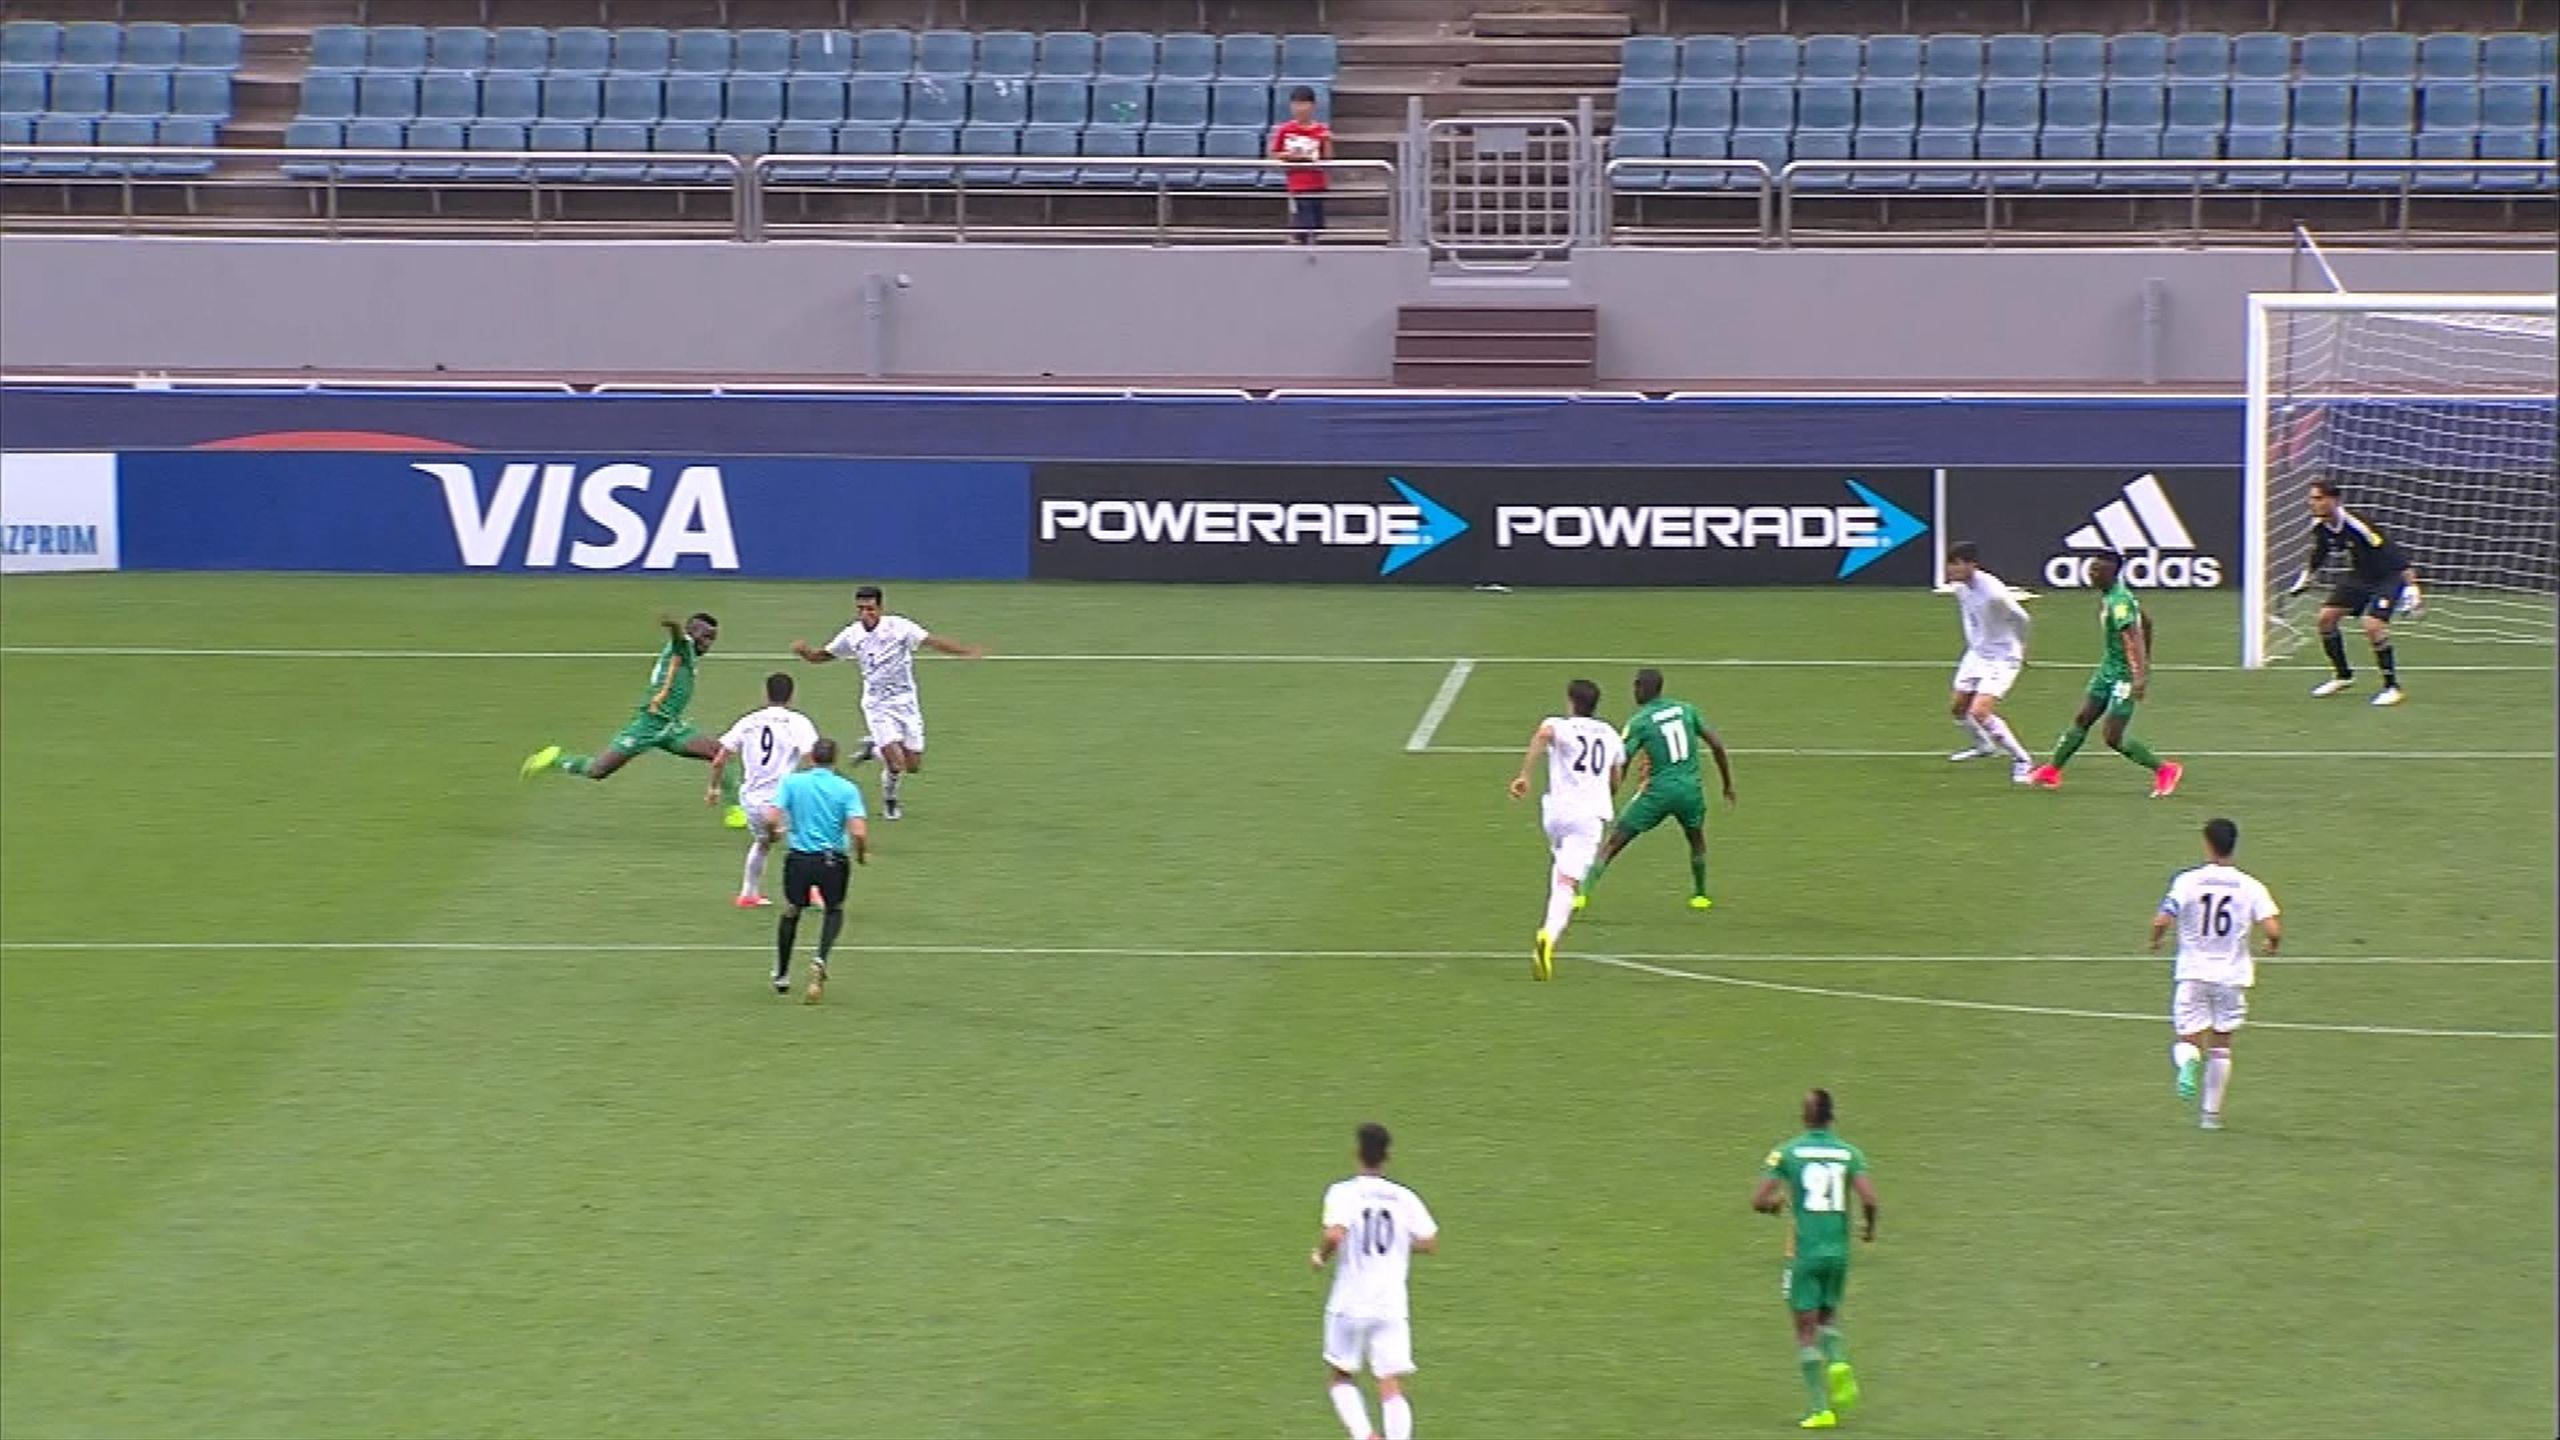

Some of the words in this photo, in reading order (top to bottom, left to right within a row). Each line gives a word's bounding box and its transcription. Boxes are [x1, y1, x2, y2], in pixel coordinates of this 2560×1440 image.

[409, 463, 740, 569] VISA
[1041, 501, 1421, 546] POWERADE
[1496, 506, 1880, 548] POWERADE
[761, 725, 774, 767] 9
[1573, 735, 1606, 776] 20
[1660, 720, 1689, 763] 11
[2200, 893, 2233, 937] 16
[1802, 1162, 1847, 1211] 21
[1362, 1208, 1395, 1256] 10
